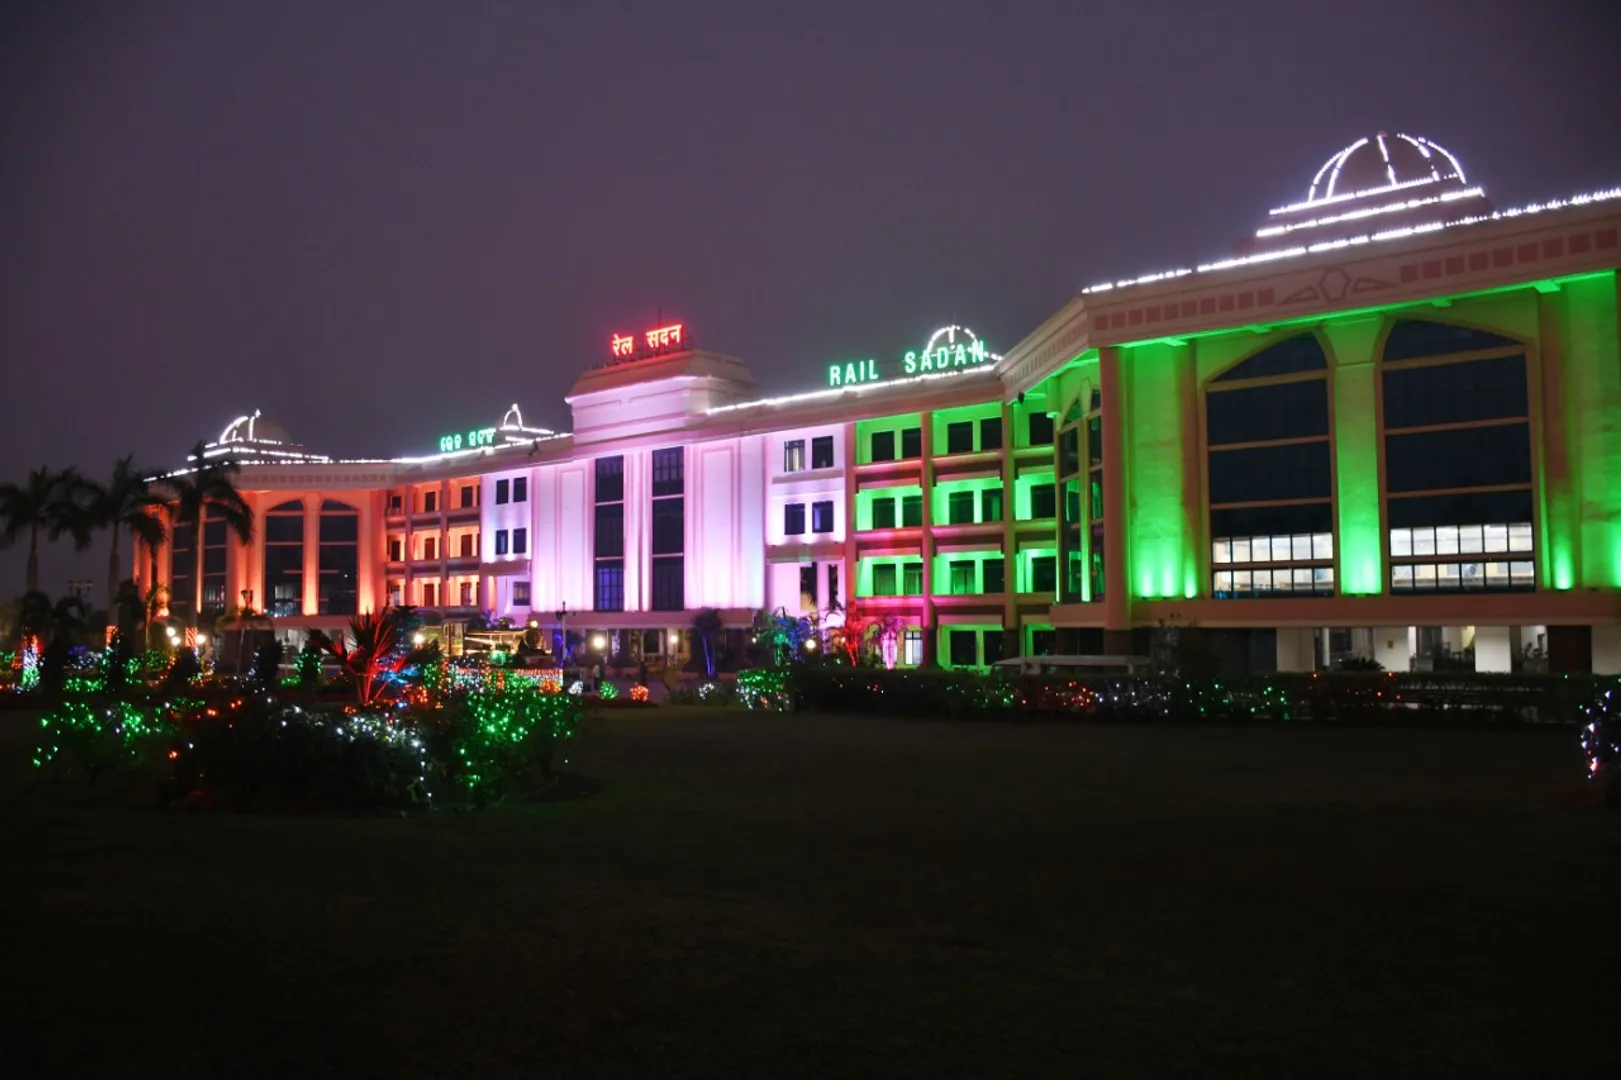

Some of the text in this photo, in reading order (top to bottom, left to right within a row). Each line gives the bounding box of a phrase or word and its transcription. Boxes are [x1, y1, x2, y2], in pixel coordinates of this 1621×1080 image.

[612, 324, 682, 356] रेल सदन
[829, 340, 984, 386] RAIL SADAN
